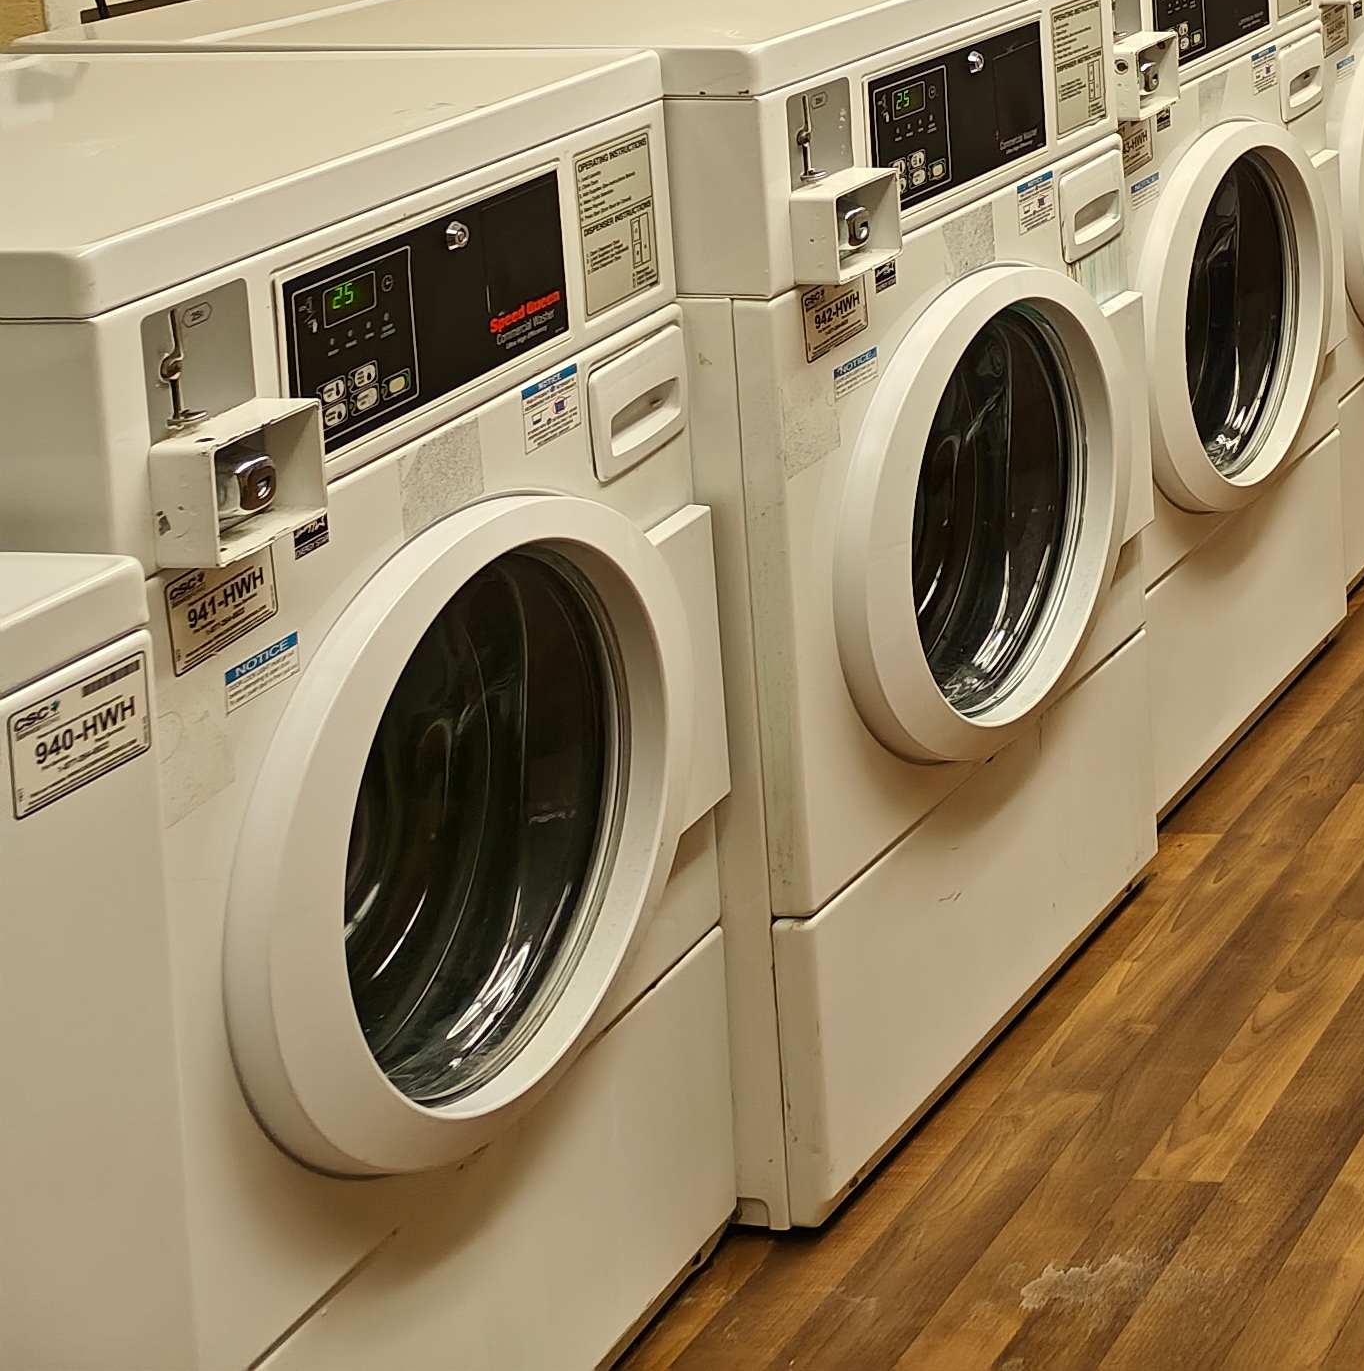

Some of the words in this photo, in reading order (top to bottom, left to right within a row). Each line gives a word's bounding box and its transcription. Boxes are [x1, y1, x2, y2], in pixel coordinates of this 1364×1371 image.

[896, 89, 910, 111] 25
[332, 281, 355, 310] 25
[490, 304, 526, 334] Speed
[526, 290, 560, 315] Queen
[814, 291, 860, 329] 942-HWH
[837, 351, 871, 375] NOTICE
[169, 576, 197, 601] CSC
[187, 566, 265, 629] 941-HWH
[235, 638, 290, 677] NOTICE
[14, 705, 50, 733] CSC
[35, 695, 136, 765] 940-HWH
